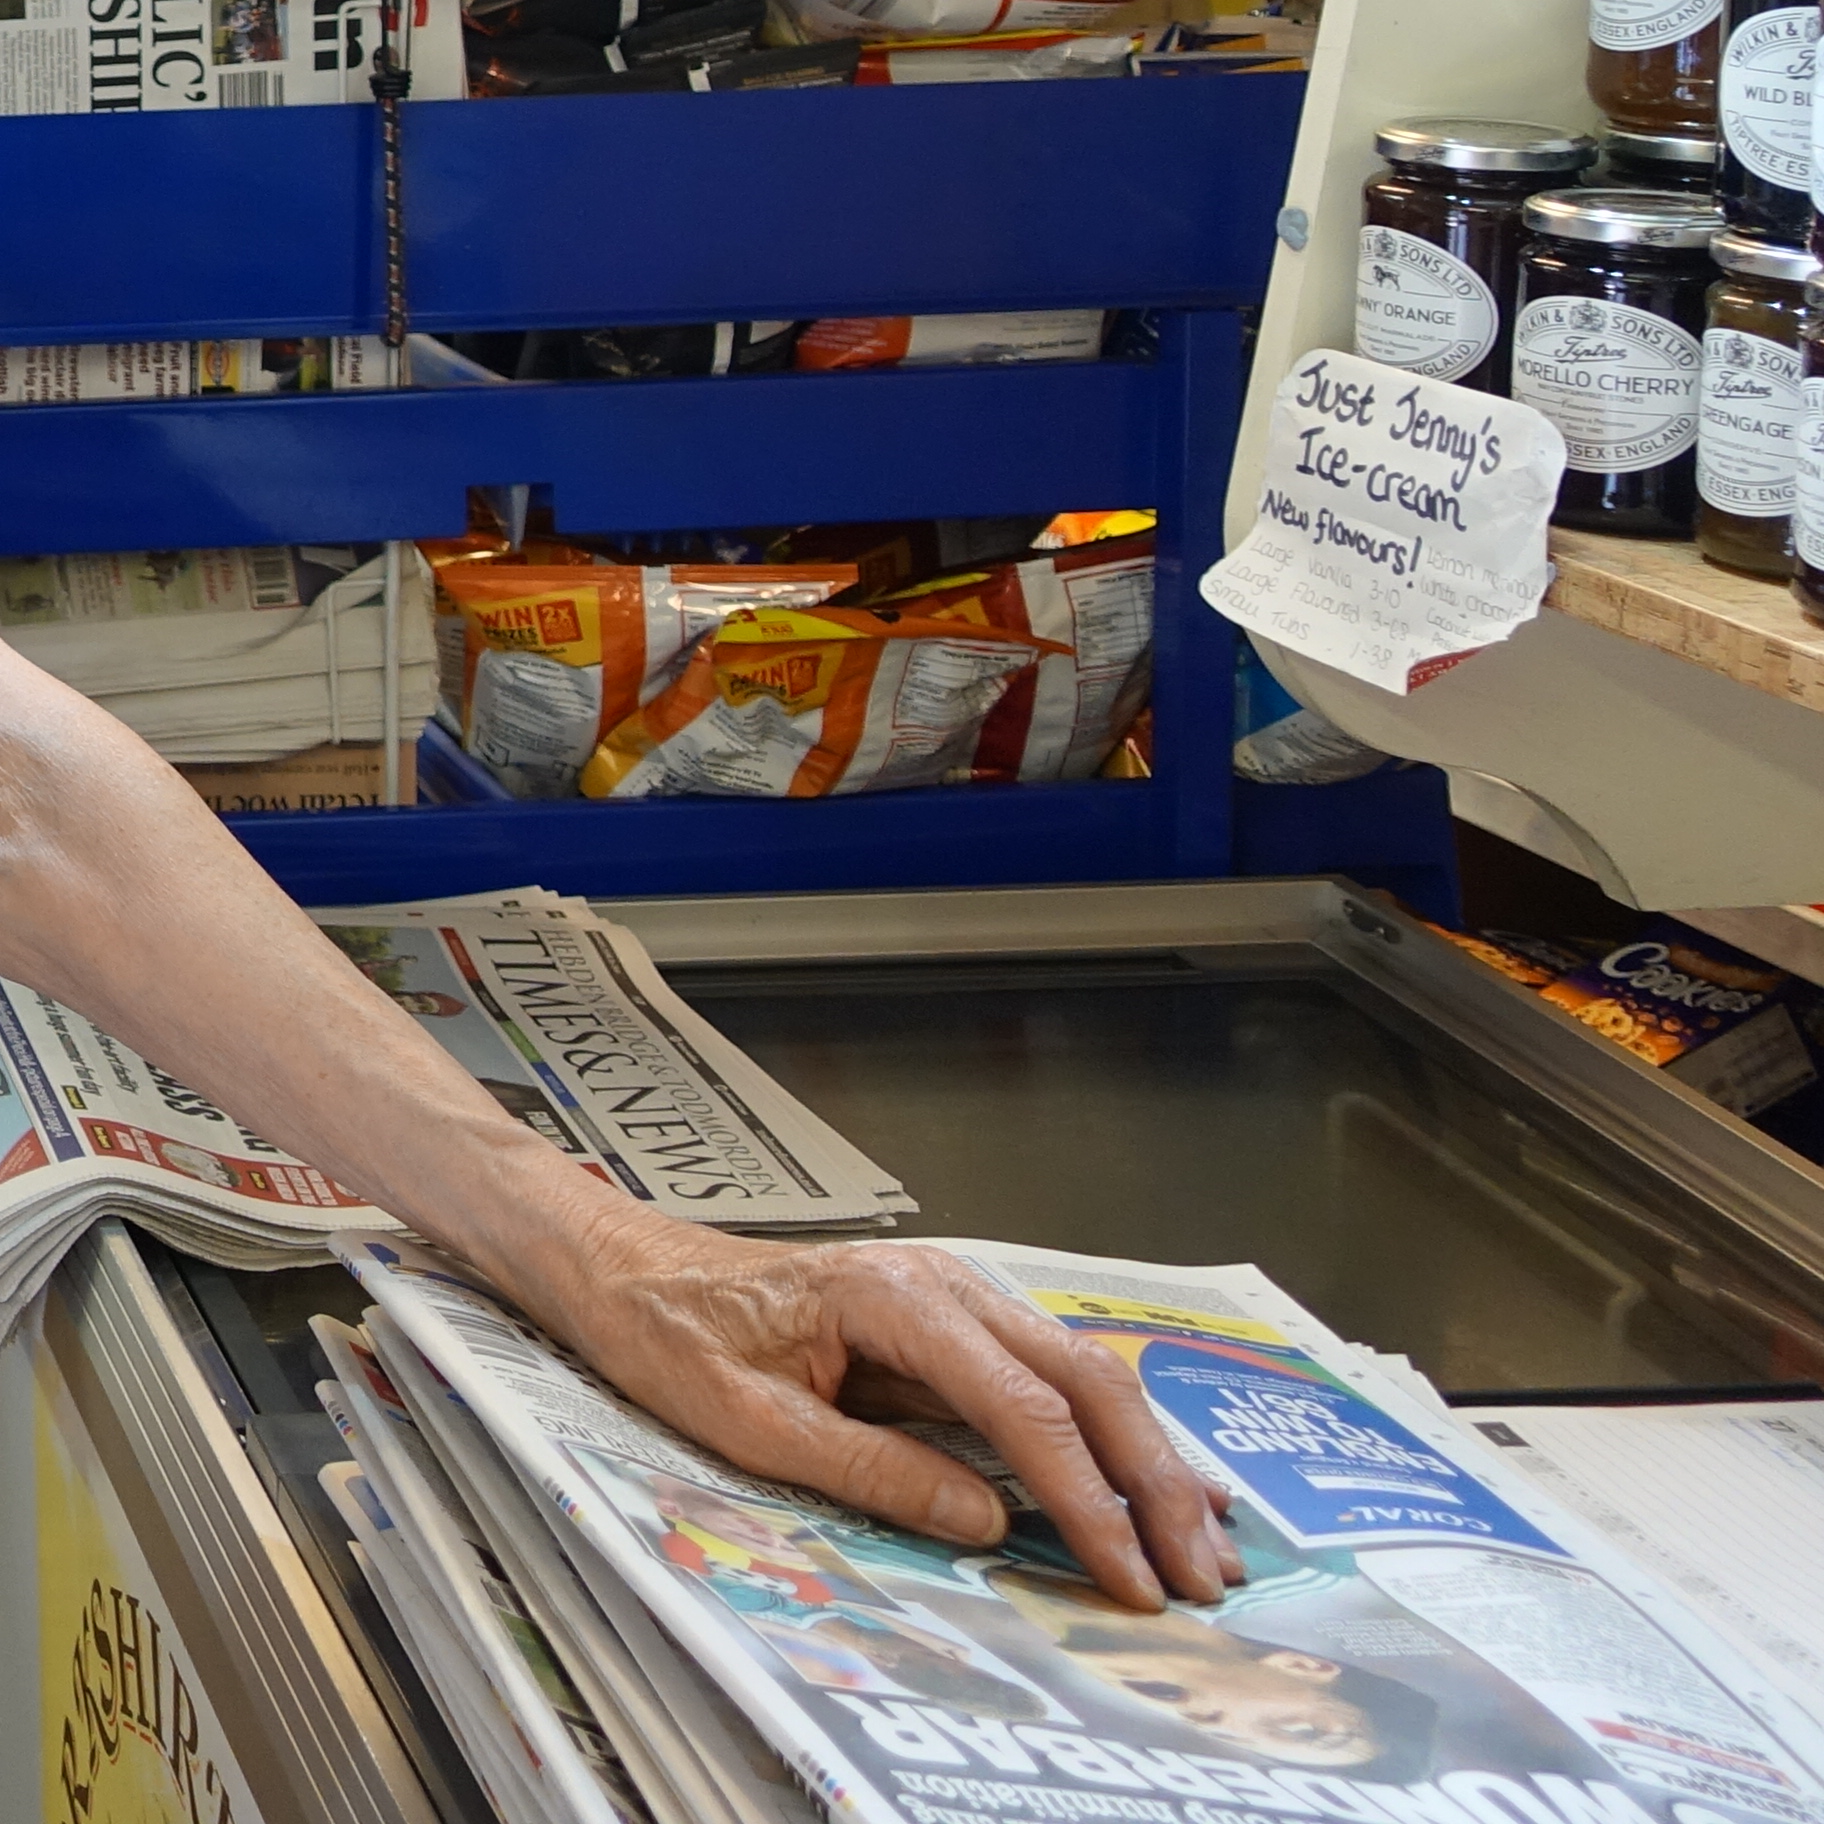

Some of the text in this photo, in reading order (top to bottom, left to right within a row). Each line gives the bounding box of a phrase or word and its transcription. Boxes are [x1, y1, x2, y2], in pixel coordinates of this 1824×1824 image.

[1732, 21, 1798, 64] WILKIN &
[1744, 84, 1789, 105] WILD
[1731, 118, 1778, 169] TIPTREE
[1399, 246, 1442, 277] SONS
[1442, 270, 1473, 298] LTD
[1384, 302, 1456, 326] ORANGE
[1554, 310, 1694, 367] & SONS LTD
[1554, 336, 1628, 362] Tiptree
[1517, 358, 1695, 397] MORELLO CHERRY
[1295, 359, 1501, 494] Just Jenny's
[1615, 415, 1692, 460] ENGLAND
[1567, 442, 1606, 460] SSEX
[1295, 425, 1467, 533] Ice-cream
[1261, 489, 1423, 589] New flavours!
[1225, 559, 1278, 595] Large
[475, 604, 534, 628] WIN
[477, 929, 753, 1200] TIMES & NEWS
[540, 928, 789, 1197] HEBDEN BRIDGE & TODMORDEN
[1214, 1385, 1332, 1416] 66/1
[529, 1386, 702, 1503] STERLING
[1218, 1404, 1422, 1448] TO WIN
[1211, 1426, 1451, 1476] ENGLAND
[1359, 1502, 1496, 1534] CORAL
